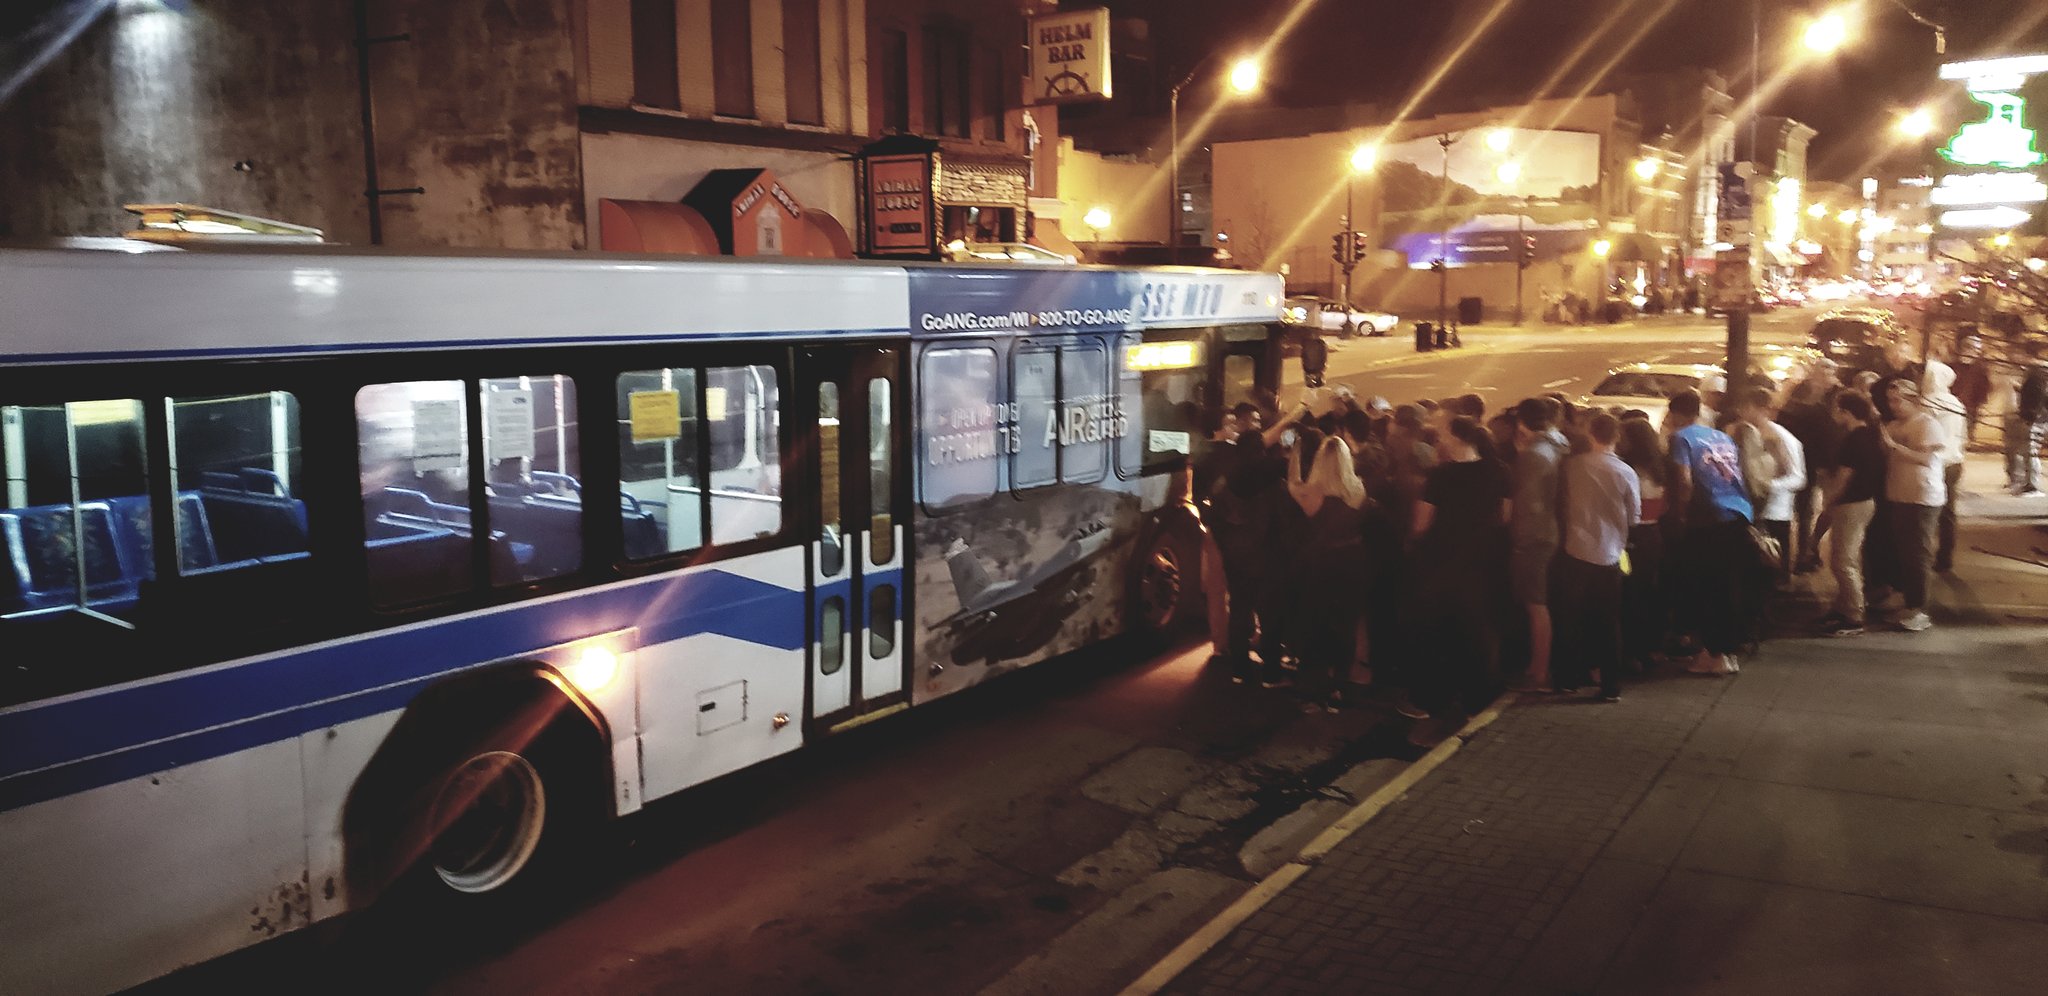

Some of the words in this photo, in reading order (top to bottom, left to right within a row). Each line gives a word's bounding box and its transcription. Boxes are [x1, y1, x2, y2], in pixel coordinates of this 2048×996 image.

[1040, 22, 1091, 45] HELM
[1048, 44, 1086, 64] BAR
[921, 310, 1029, 331] GoANG.com/WI
